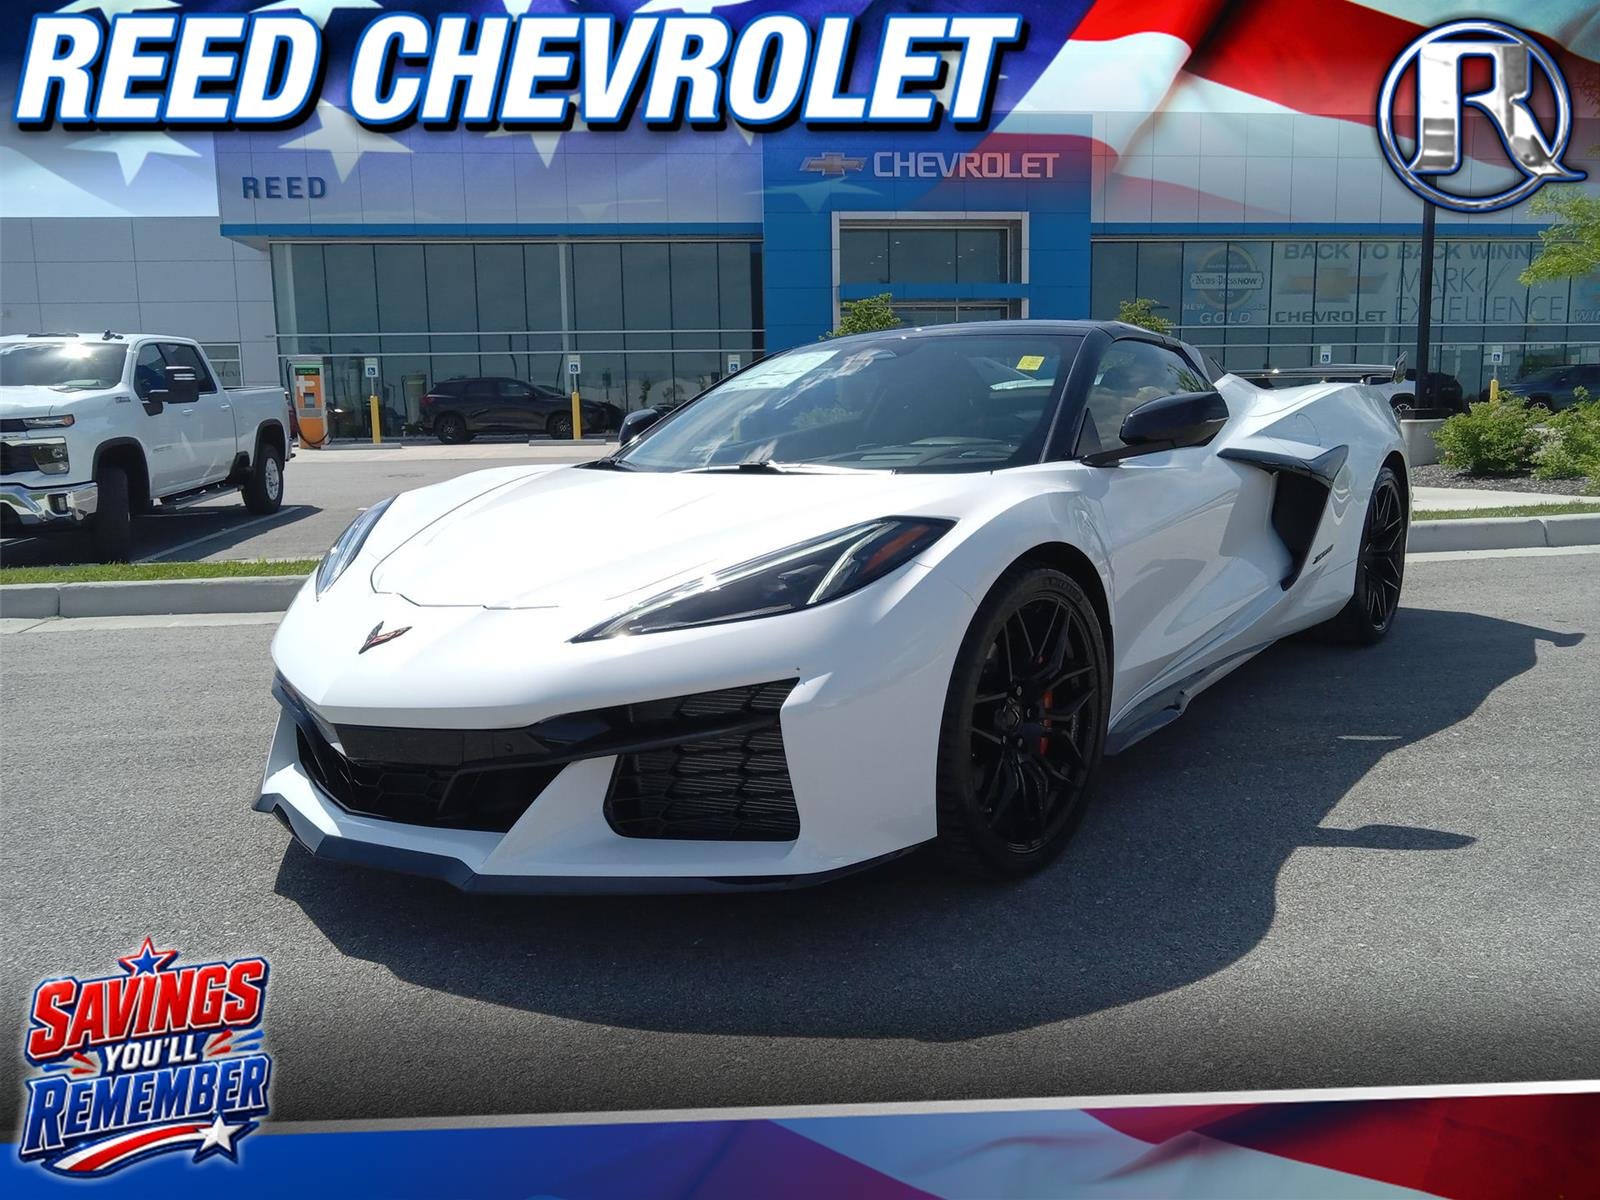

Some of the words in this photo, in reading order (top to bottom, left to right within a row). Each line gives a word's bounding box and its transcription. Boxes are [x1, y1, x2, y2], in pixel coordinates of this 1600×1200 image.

[873, 151, 1060, 178] CHEVROLET
[242, 176, 327, 199] REED
[1284, 243, 1350, 260] BACK
[1359, 243, 1389, 260] TO
[1470, 243, 1543, 260] WINNE
[1395, 266, 1477, 294] MARK
[1200, 312, 1251, 325] GOLD
[1275, 310, 1387, 323] CHEVROLET
[1395, 295, 1563, 323] EXCELLENCE
